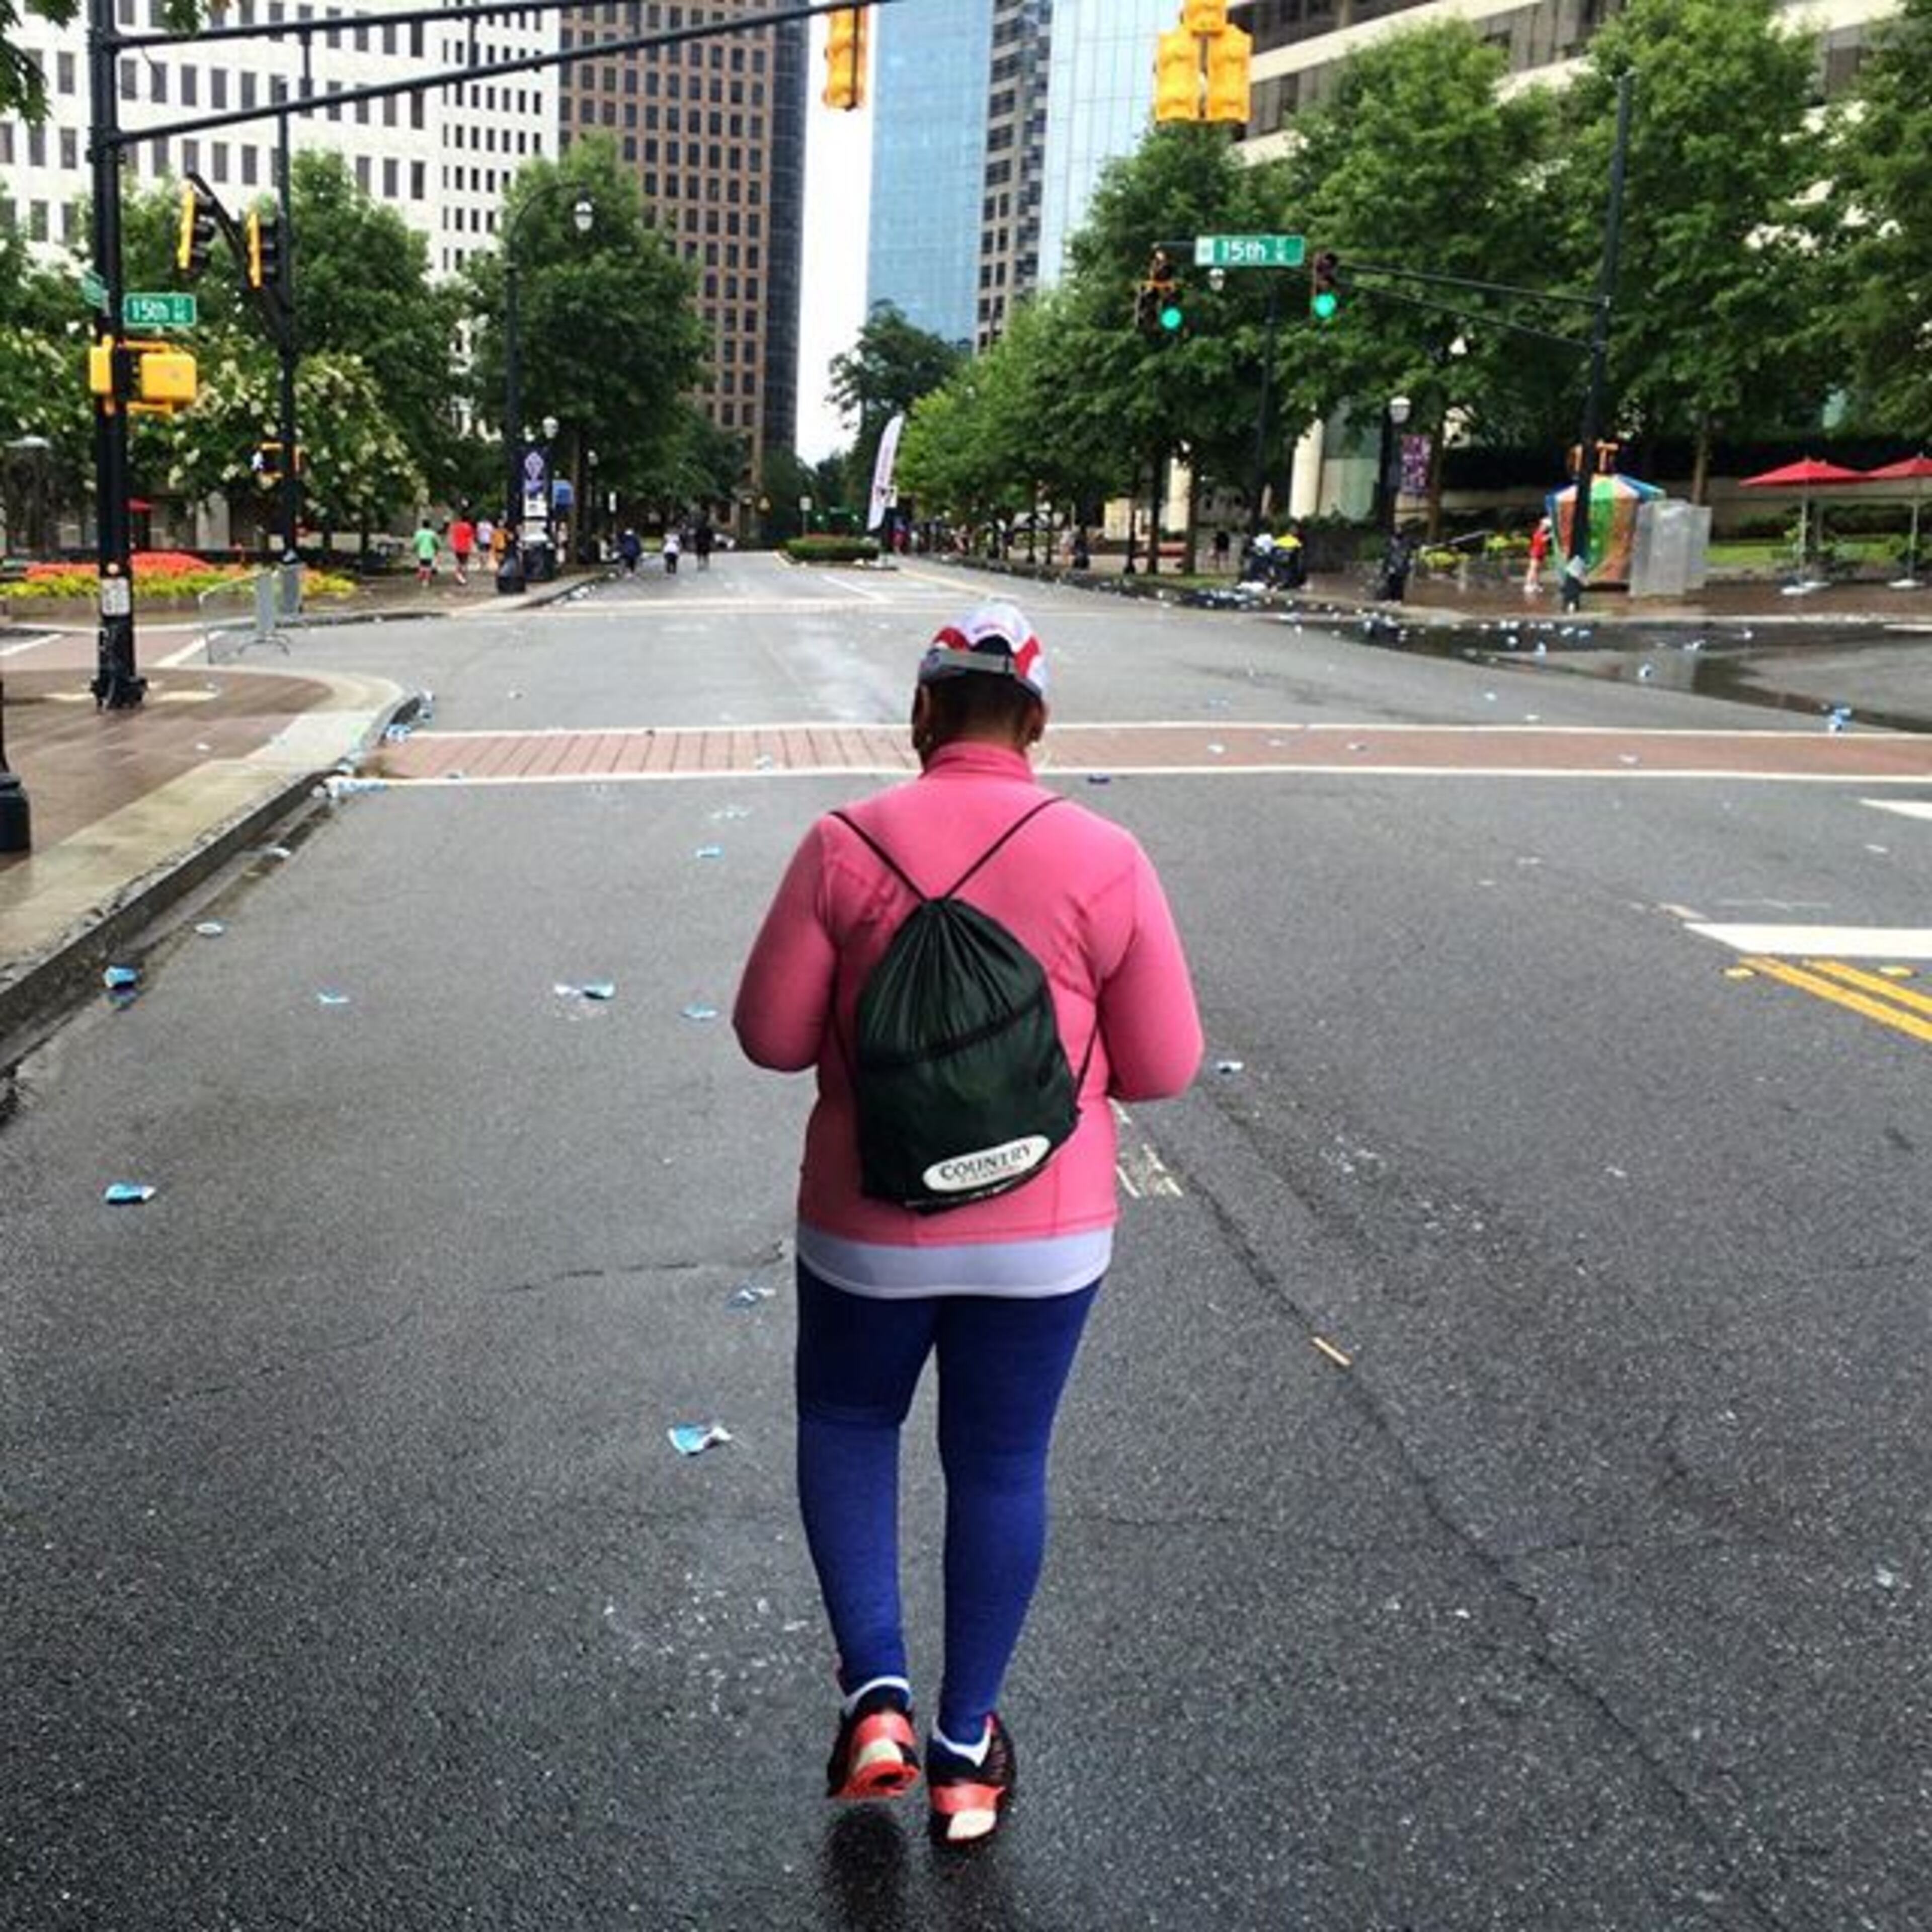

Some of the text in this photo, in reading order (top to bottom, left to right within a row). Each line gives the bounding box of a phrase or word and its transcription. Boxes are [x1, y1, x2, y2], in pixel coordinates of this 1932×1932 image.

[1222, 240, 1267, 262] 15th
[132, 298, 170, 321] 15th
[938, 1143, 1031, 1181] COUNTRY
